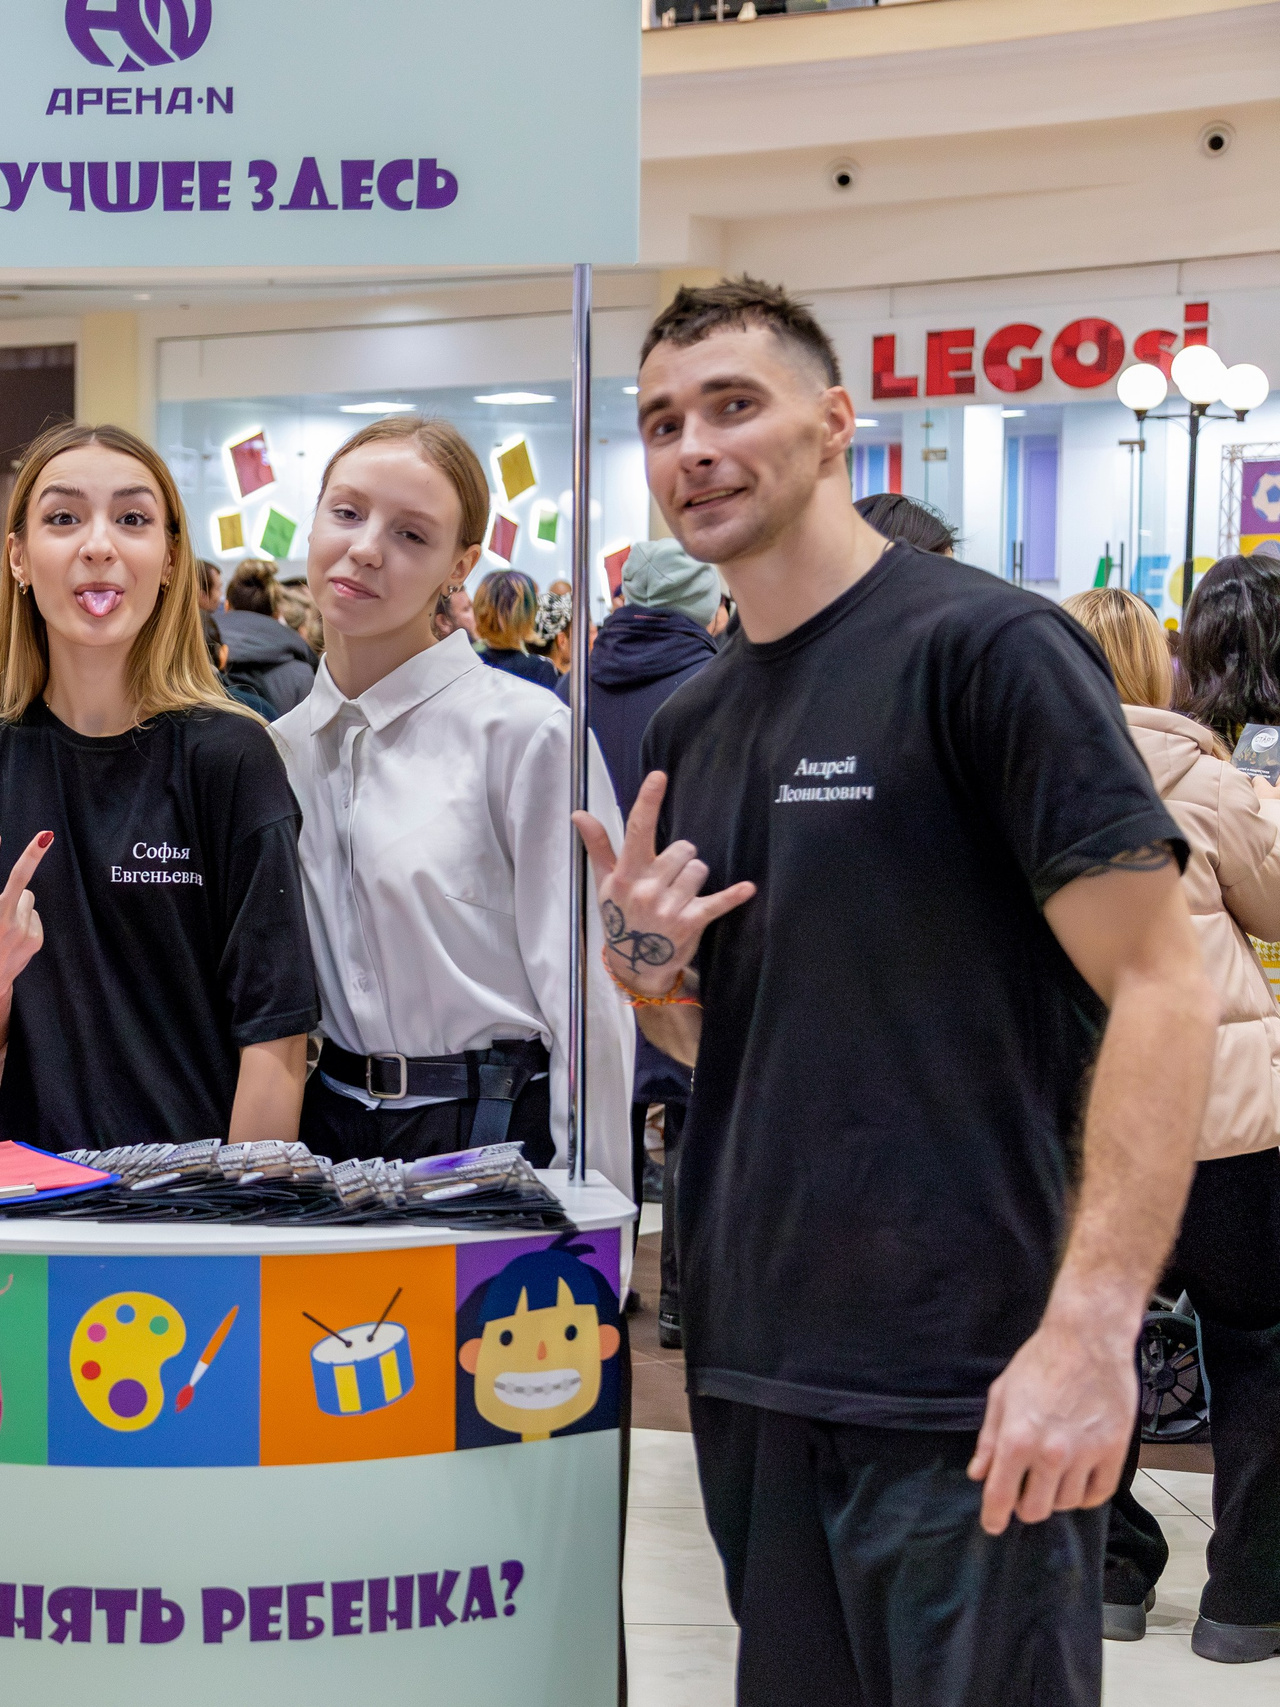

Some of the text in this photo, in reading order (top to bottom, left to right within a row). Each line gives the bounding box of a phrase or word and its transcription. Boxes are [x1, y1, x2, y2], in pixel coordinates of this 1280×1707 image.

[246, 156, 460, 213] ЗДЕСЬ
[794, 755, 857, 780] Андрей
[774, 784, 875, 804] Леонидович
[132, 842, 191, 863] Софья
[200, 1558, 526, 1645] РЕБЕНКА?
